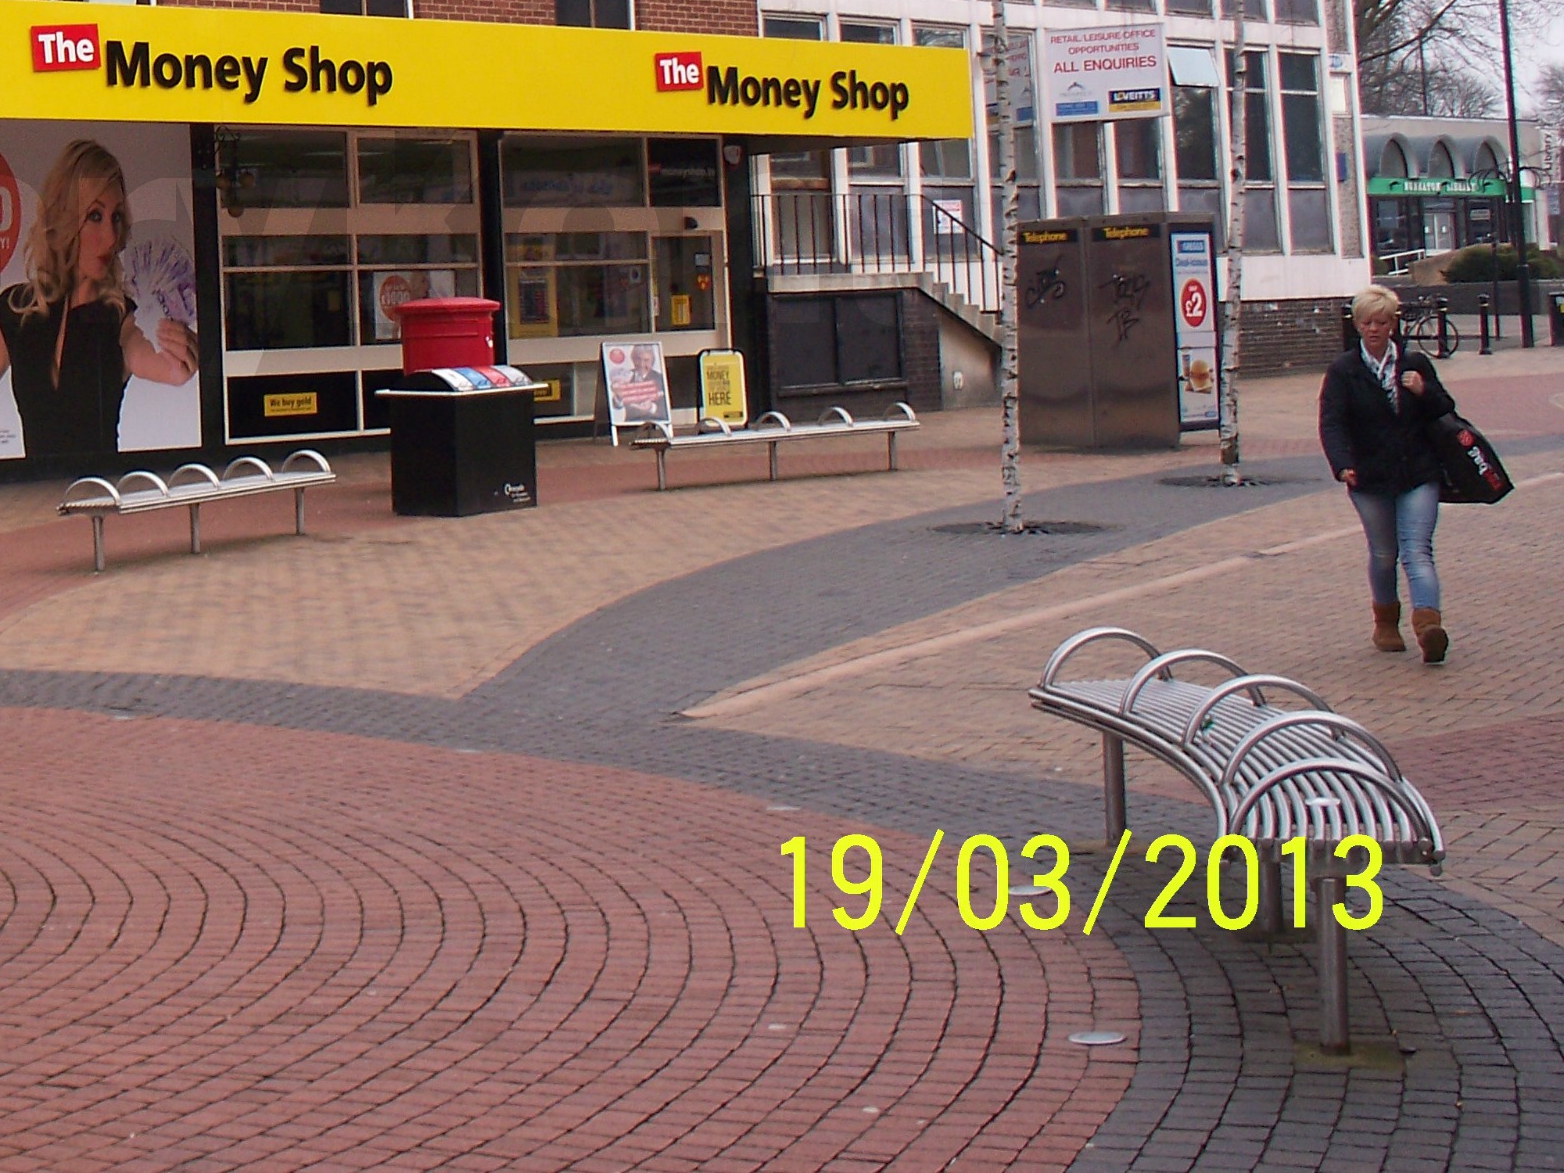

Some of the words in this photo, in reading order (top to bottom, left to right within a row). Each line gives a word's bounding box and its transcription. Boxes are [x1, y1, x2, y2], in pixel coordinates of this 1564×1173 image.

[1068, 42, 1140, 55] OPPORTUNITIES
[38, 31, 94, 64] The
[105, 40, 268, 104] Money
[283, 45, 394, 107] Shop
[1054, 62, 1079, 74] ALL
[1083, 55, 1157, 71] ENQUIRIES
[659, 58, 700, 85] The
[706, 66, 821, 119] Money
[831, 70, 909, 121] Shop
[1544, 133, 1554, 171] Library
[1024, 232, 1068, 244] Telephone
[1103, 227, 1150, 240] Telephone
[1185, 292, 1203, 318] £2
[707, 370, 729, 381] MONEY
[709, 392, 731, 406] HERE
